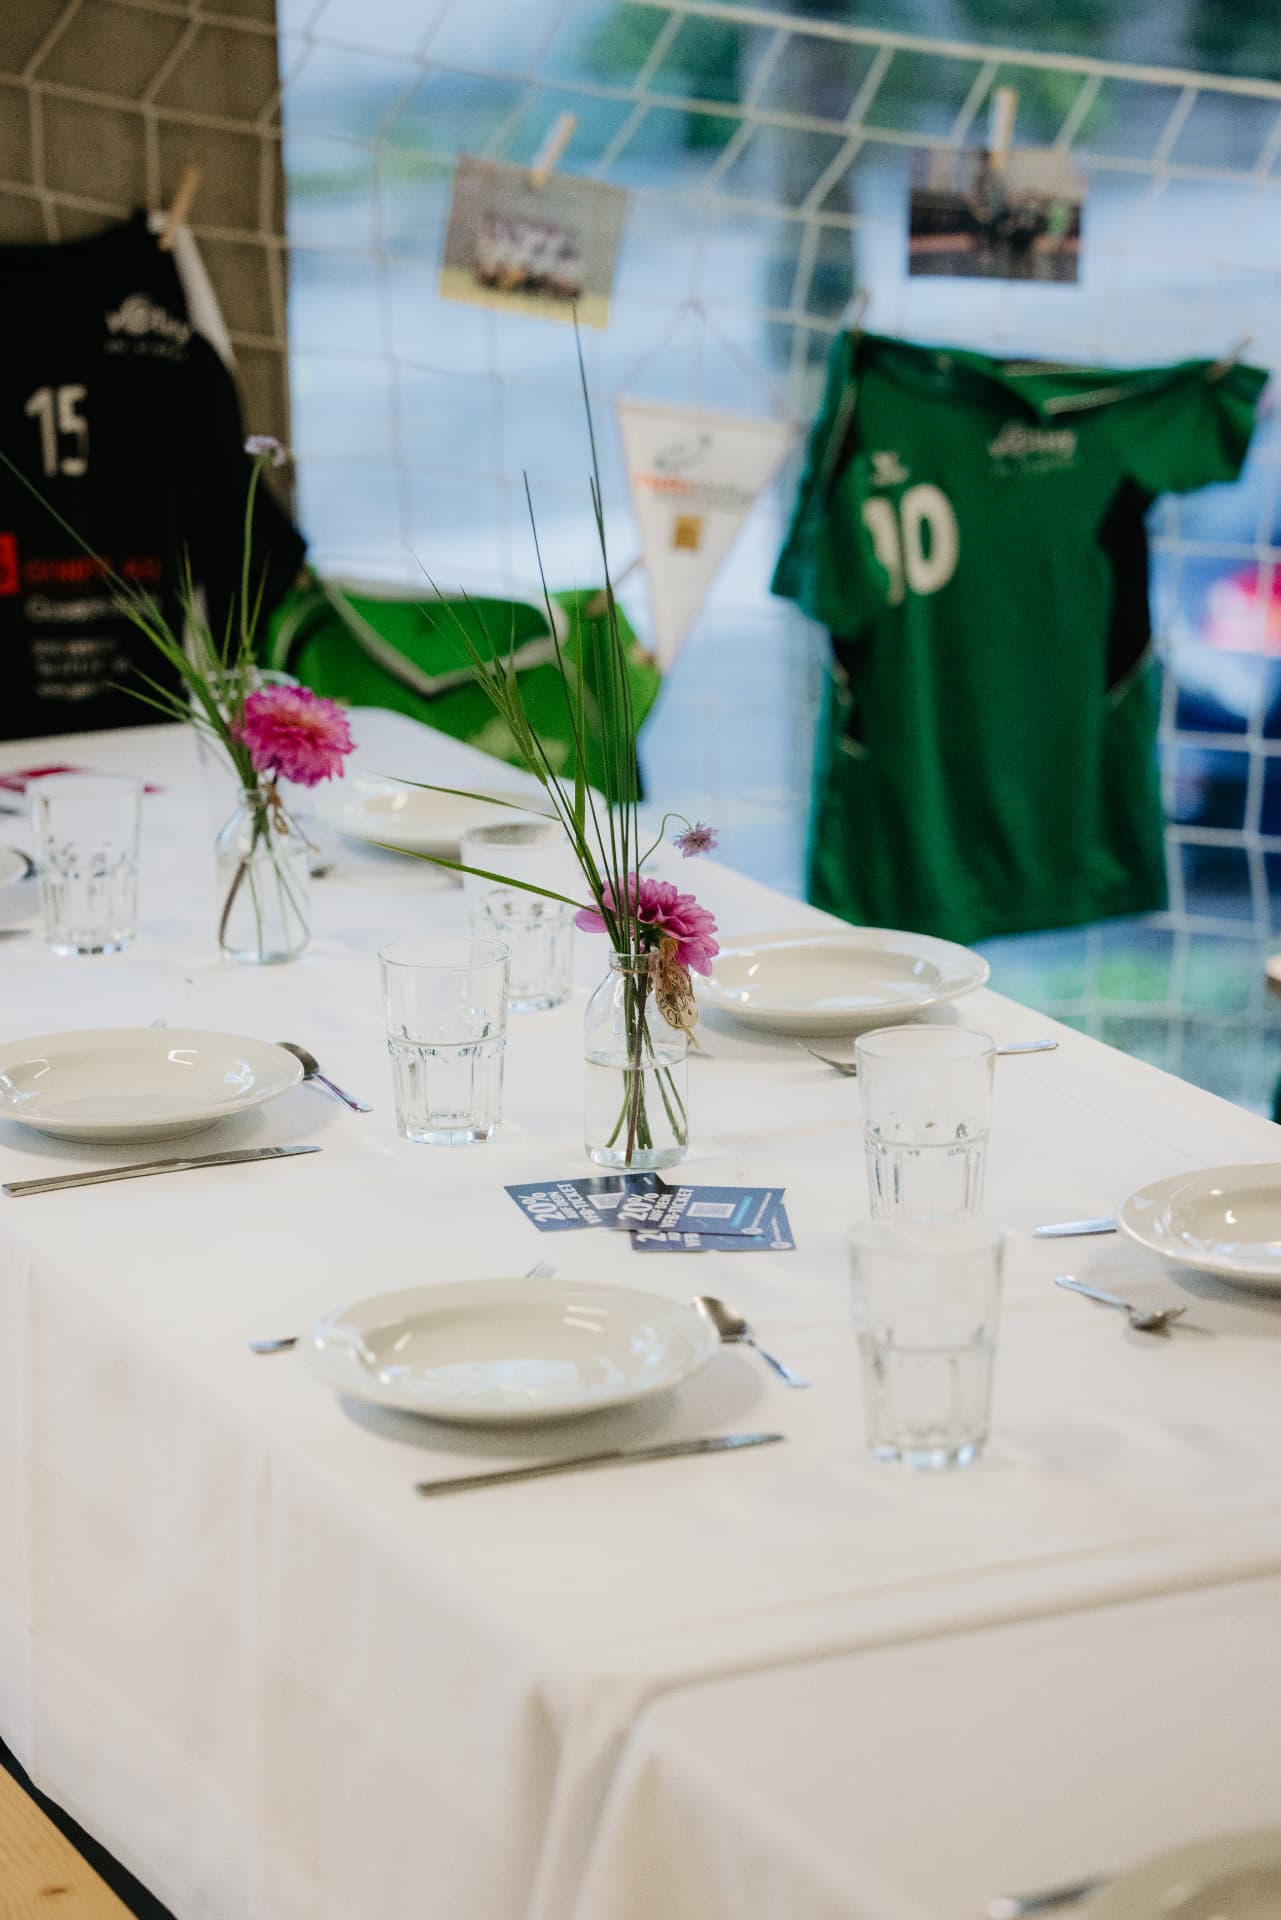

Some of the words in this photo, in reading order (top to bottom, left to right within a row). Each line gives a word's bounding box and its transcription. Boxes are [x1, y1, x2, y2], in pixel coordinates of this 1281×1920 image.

[25, 385, 89, 476] 15
[862, 483, 959, 604] 10
[518, 1192, 567, 1222] 20%
[617, 1193, 660, 1222] 20%
